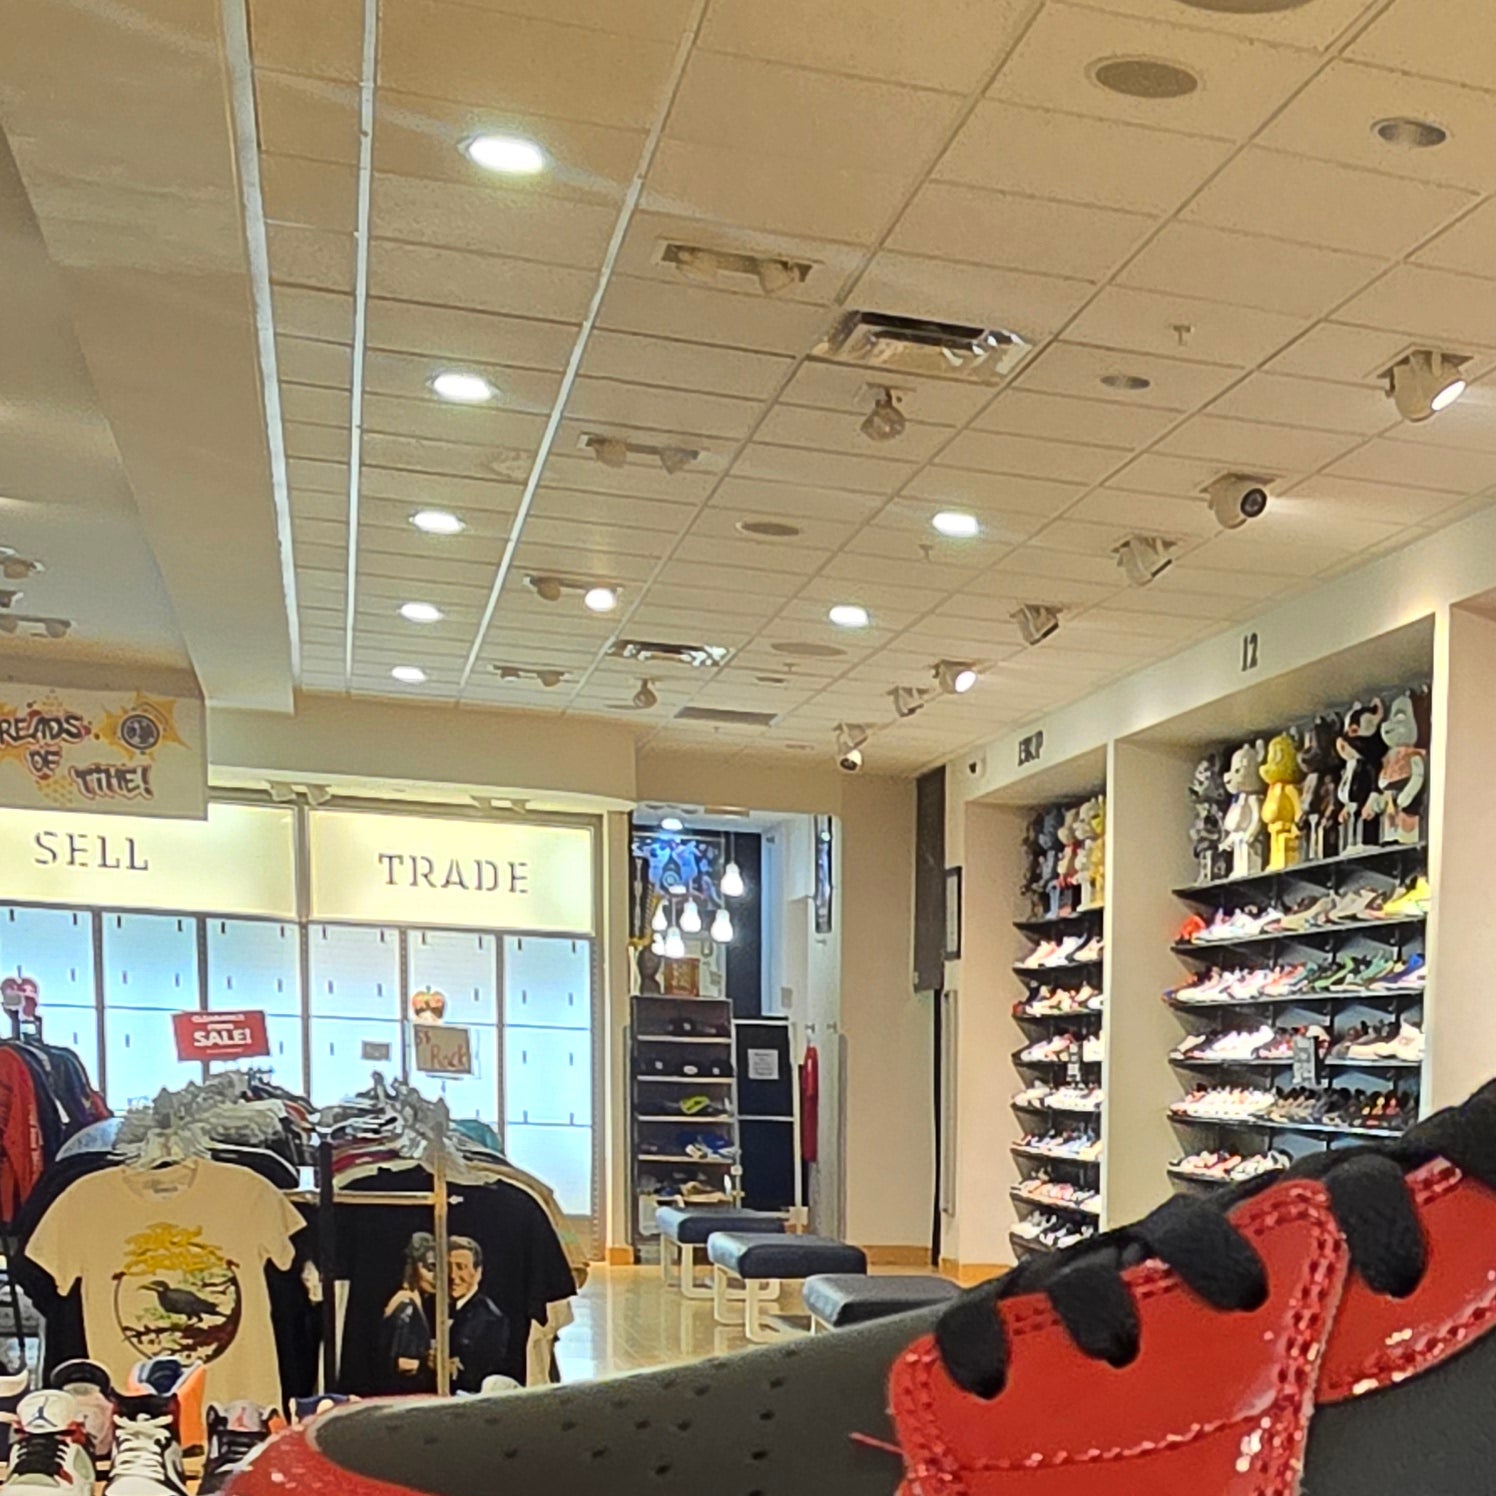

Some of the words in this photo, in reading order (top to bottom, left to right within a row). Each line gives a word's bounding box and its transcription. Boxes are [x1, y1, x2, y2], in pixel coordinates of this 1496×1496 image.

[1241, 632, 1258, 672] 12
[34, 831, 150, 870] SELL
[378, 853, 530, 893] TRADE
[194, 1028, 252, 1047] SALE!
